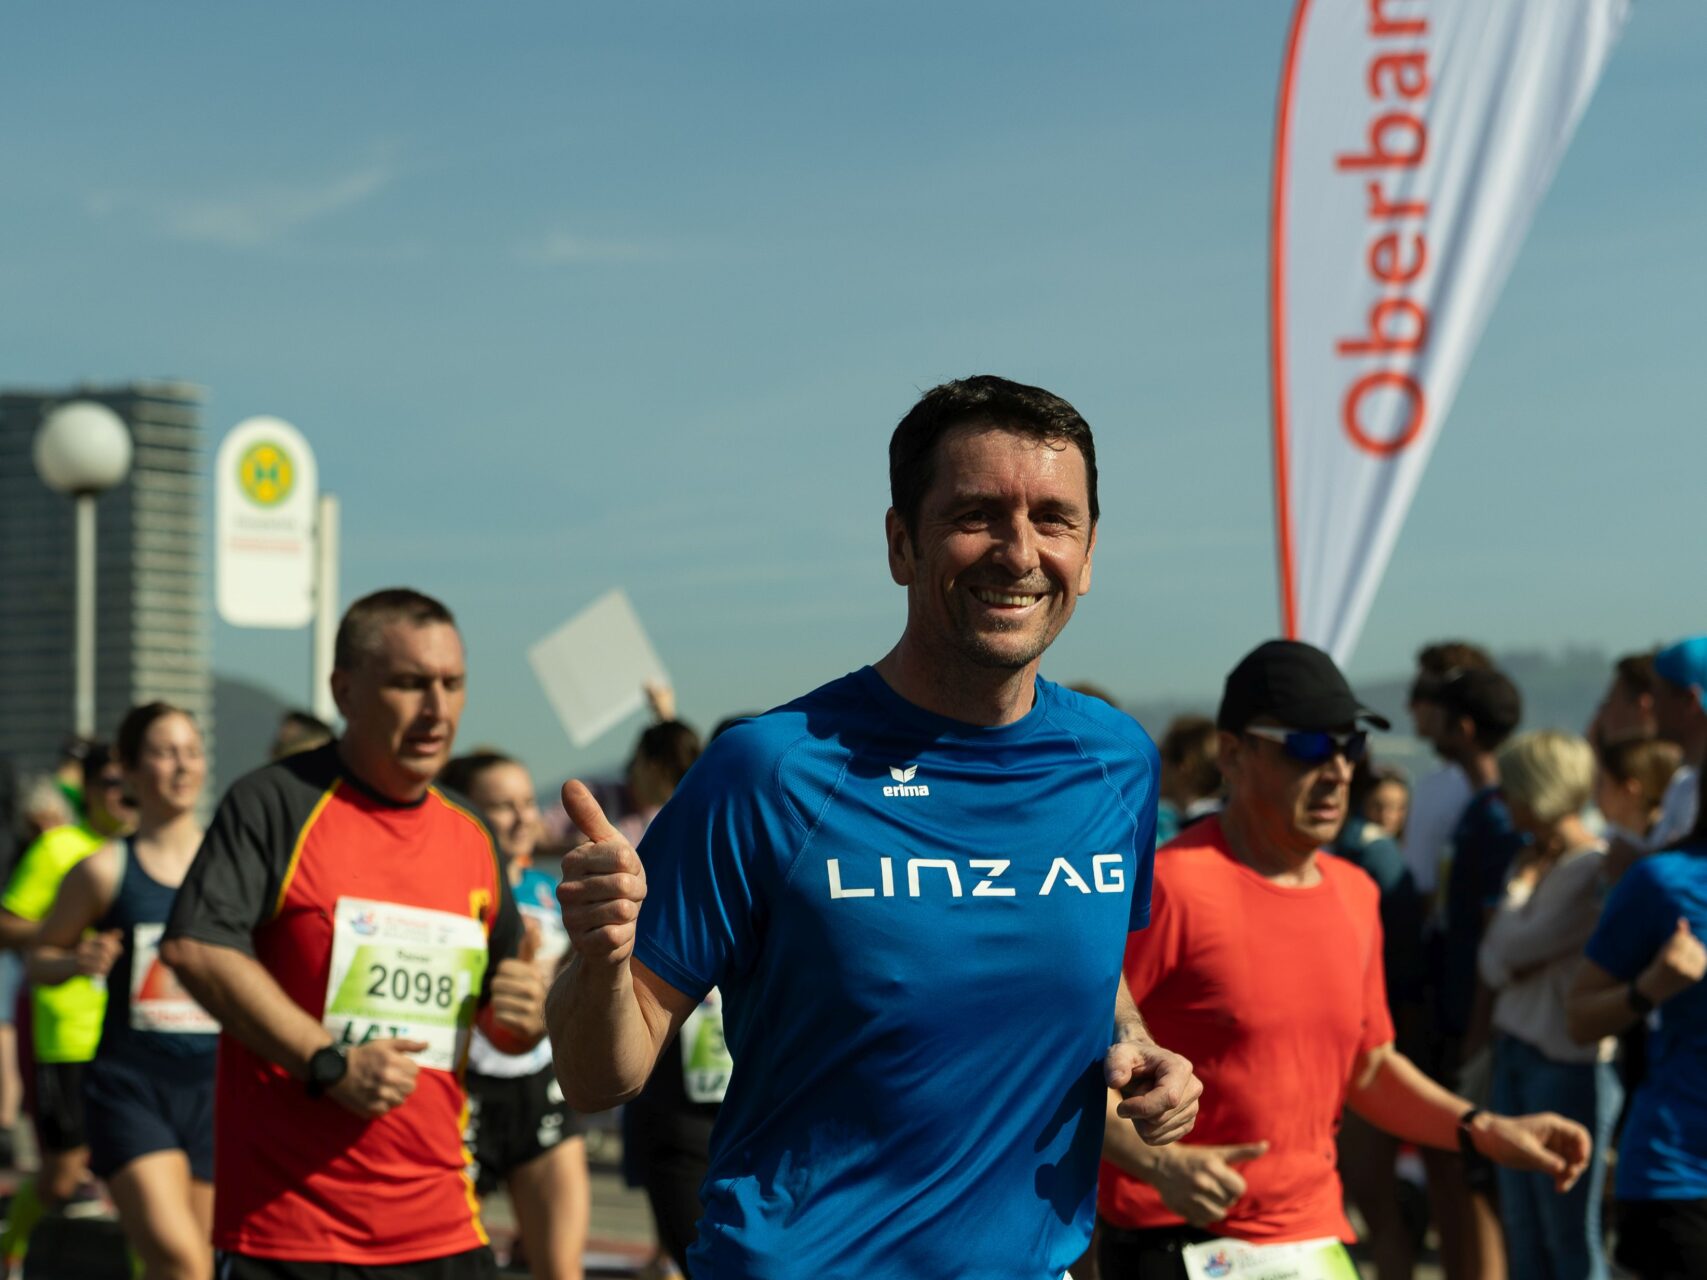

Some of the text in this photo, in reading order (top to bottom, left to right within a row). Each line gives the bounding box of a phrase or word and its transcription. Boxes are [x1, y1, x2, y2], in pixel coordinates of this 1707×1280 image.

[883, 785, 929, 797] erima
[1039, 854, 1125, 896] AG
[366, 964, 454, 1009] 2098
